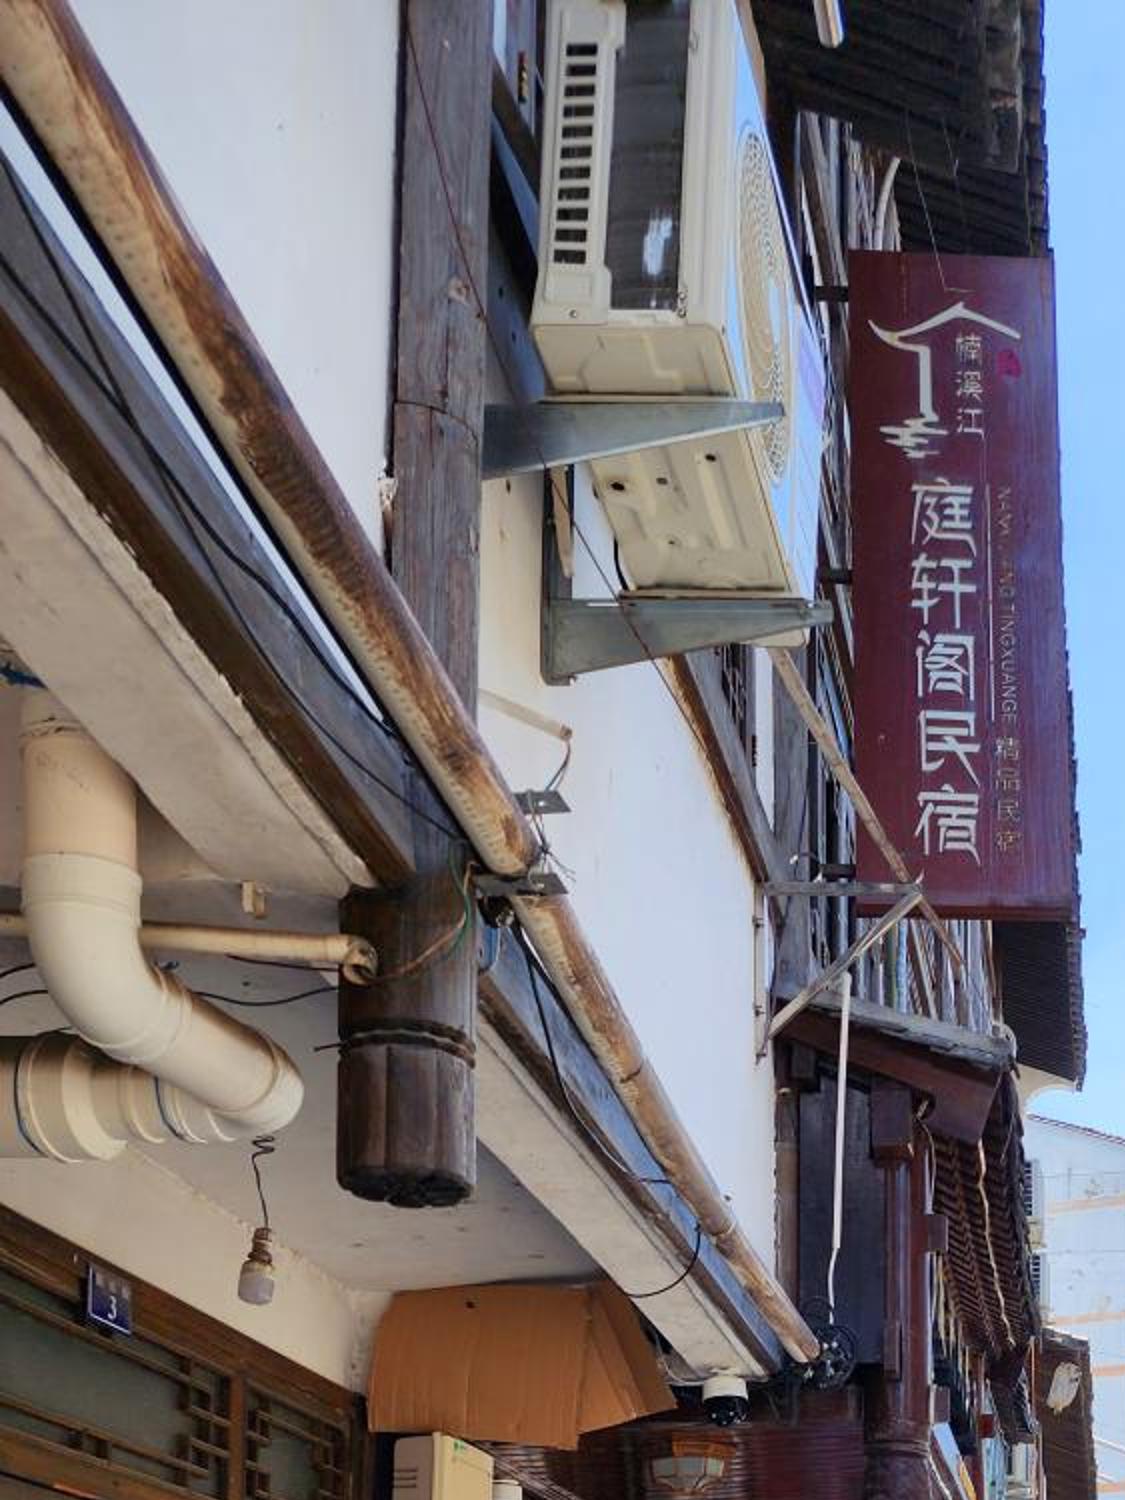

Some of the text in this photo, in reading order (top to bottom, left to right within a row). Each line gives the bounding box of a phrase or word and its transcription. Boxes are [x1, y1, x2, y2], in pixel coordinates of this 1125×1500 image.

[911, 477, 981, 867] 庭轩阁民宿
